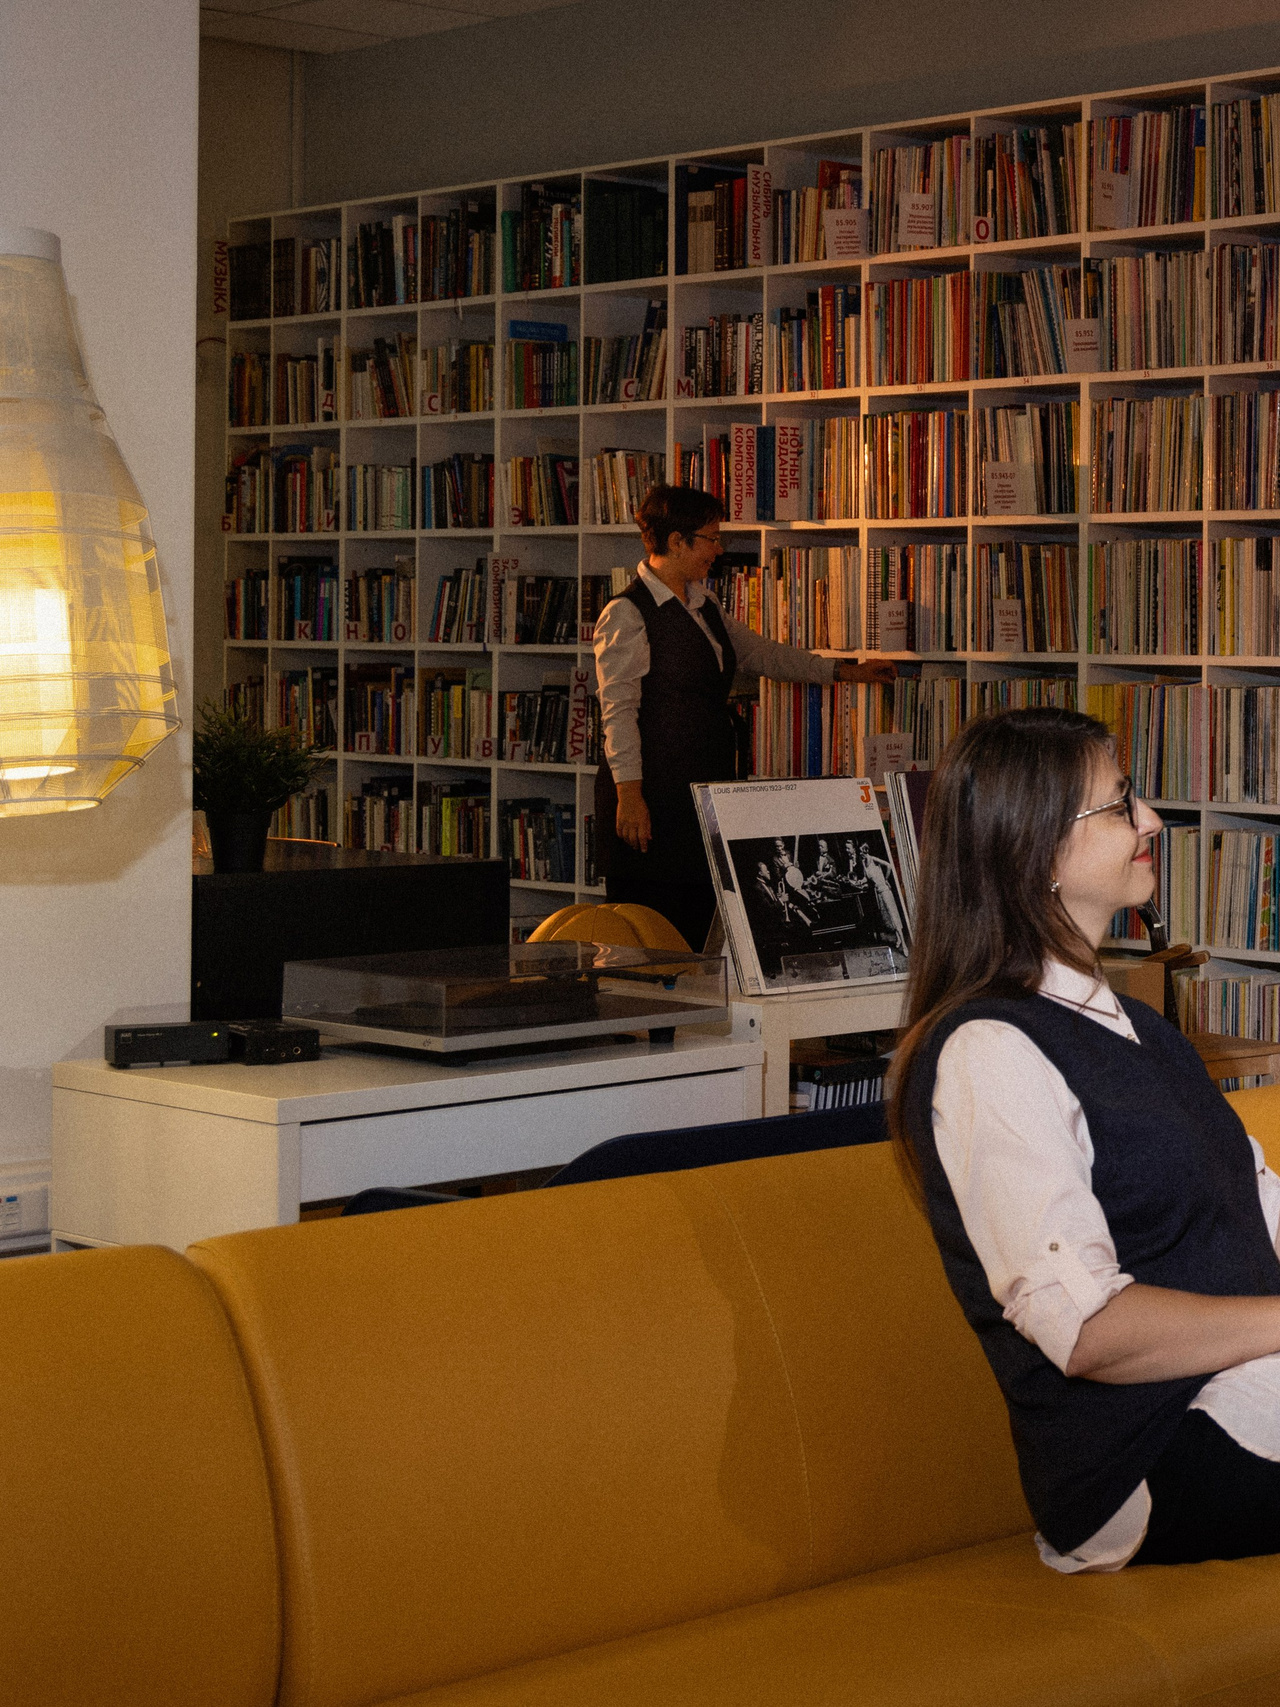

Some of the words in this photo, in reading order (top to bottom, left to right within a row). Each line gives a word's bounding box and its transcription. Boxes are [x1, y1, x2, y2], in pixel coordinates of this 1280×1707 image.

[763, 171, 772, 218] СИБИРЬ
[752, 170, 761, 260] МУЗЫКАЛЬНАЯ
[911, 203, 933, 211] 85.907
[836, 219, 857, 227] 85.905
[975, 220, 989, 240] О
[213, 240, 228, 314] МУЗЫКА
[1266, 362, 1274, 370] 36
[624, 381, 635, 398] С
[676, 379, 691, 397] М
[322, 392, 335, 409] Д
[427, 395, 439, 412] С
[745, 428, 755, 498] СИБИРСКИЕ
[778, 426, 789, 498] ИЗДАНИЯ
[789, 427, 800, 490] НОТНЫЕ
[734, 427, 744, 520] КОМПОЗИТОРЫ
[221, 515, 232, 532] Б
[511, 507, 522, 525] Э
[492, 558, 502, 638] КОМПОЗИТОРЫ
[298, 623, 309, 639] К
[346, 624, 359, 640] Н
[394, 624, 406, 641] О
[466, 624, 477, 640] Т
[581, 626, 595, 641] Ш
[568, 670, 589, 758] ЭСТРАДА
[358, 734, 370, 751] П
[431, 738, 442, 754] У
[482, 740, 493, 758] В
[510, 744, 522, 760] Г
[714, 787, 731, 795] LOUIS
[732, 784, 769, 794] ARMSTRONG
[860, 785, 871, 803] J
